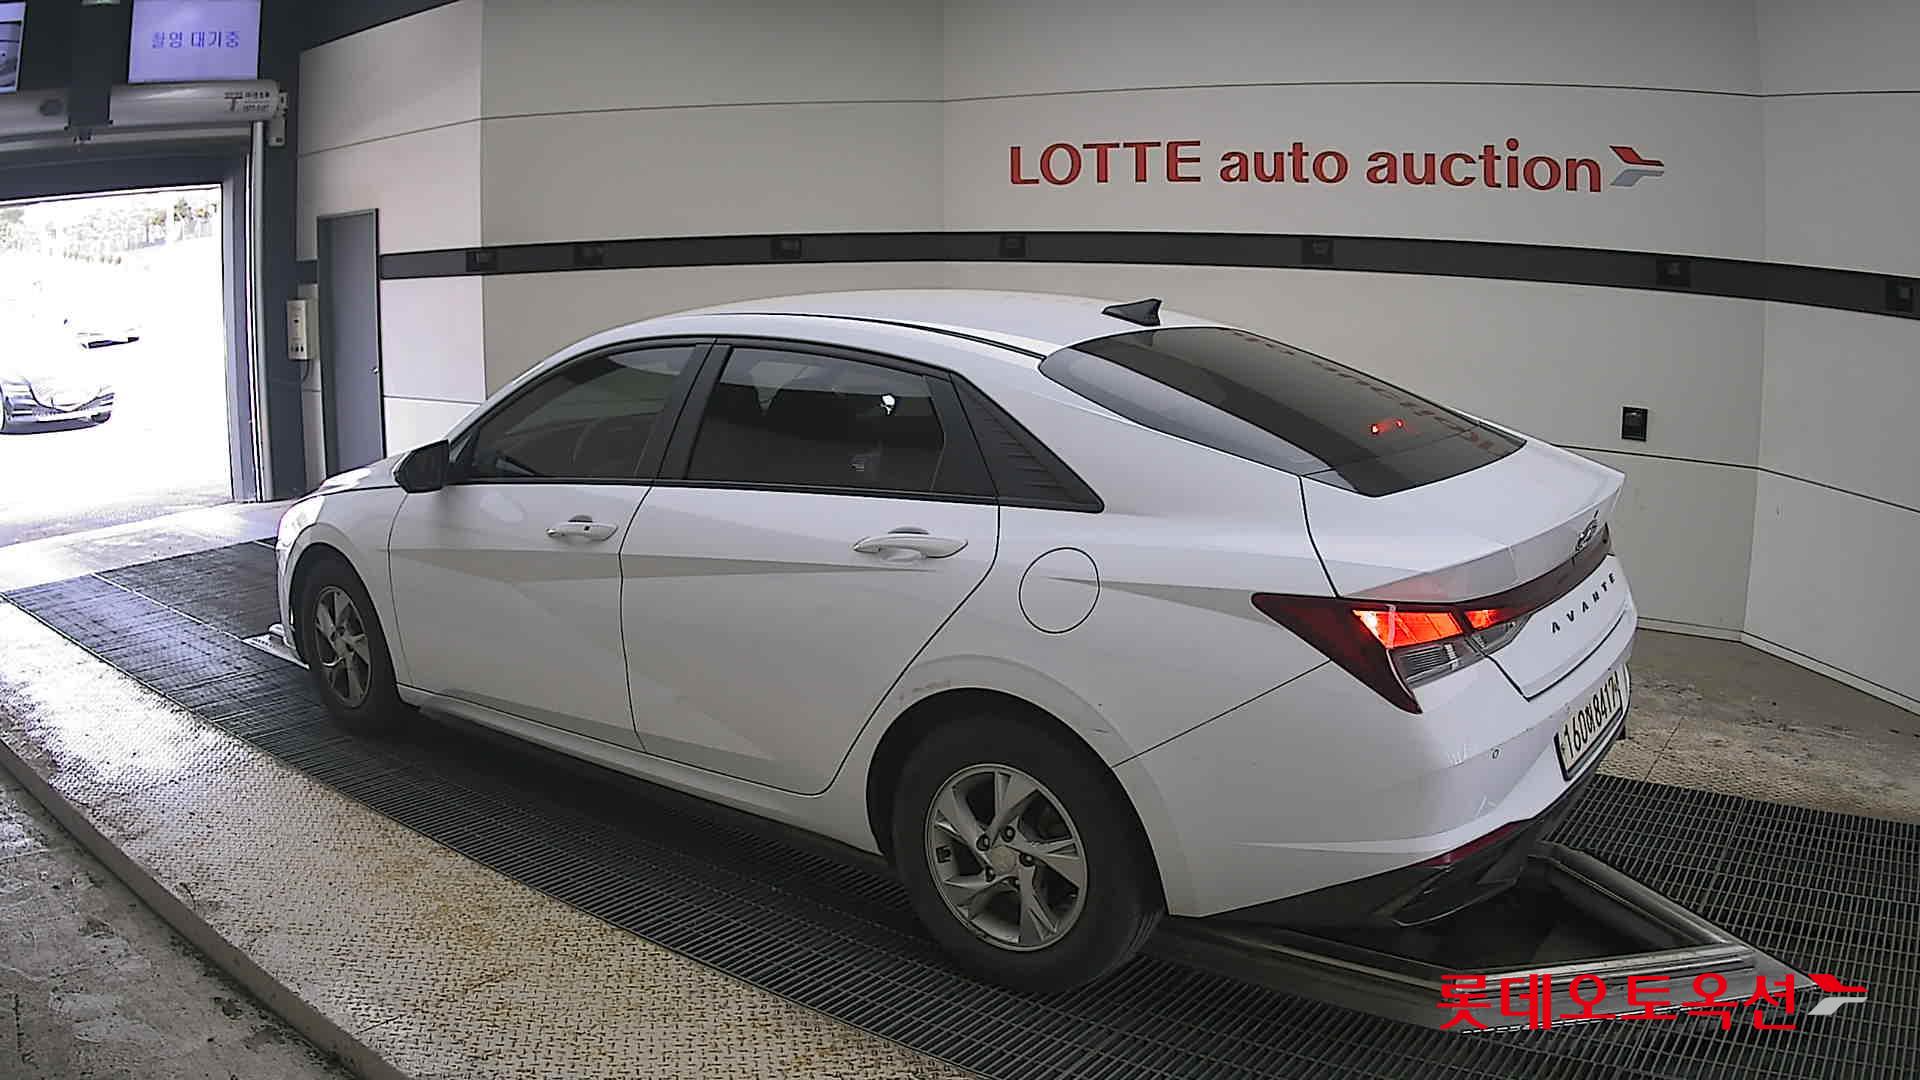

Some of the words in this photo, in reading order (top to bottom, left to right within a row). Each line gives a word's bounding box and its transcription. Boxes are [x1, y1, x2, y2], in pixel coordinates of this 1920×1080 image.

[191, 31, 240, 49] 대기중
[1010, 140, 1201, 186] LOTTE
[1219, 141, 1349, 184] auto
[1366, 137, 1601, 193] auction
[1551, 572, 1616, 634] AVANTE
